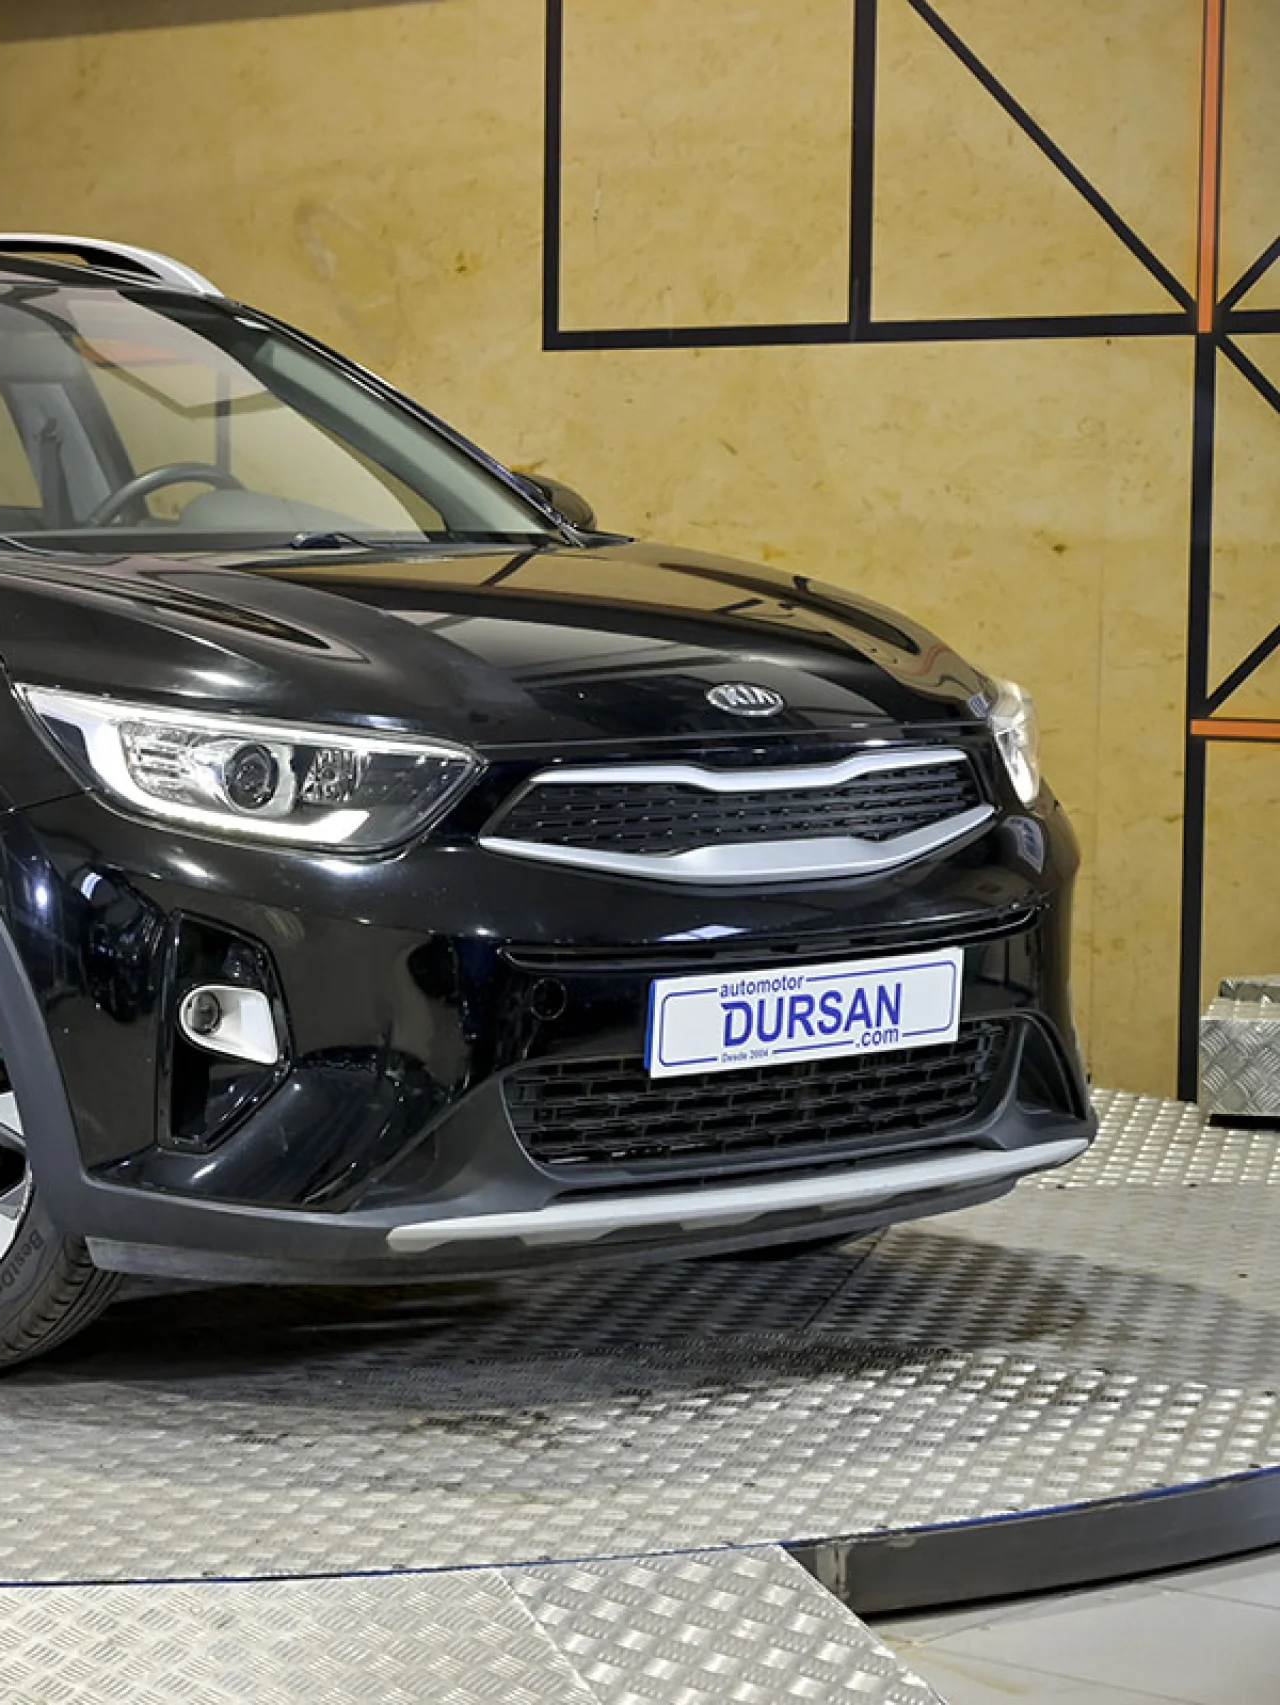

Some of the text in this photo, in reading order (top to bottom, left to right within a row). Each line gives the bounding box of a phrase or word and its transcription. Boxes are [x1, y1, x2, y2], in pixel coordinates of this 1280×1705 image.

[720, 975, 804, 998] automotor
[720, 982, 903, 1048] DURSAN
[854, 1028, 899, 1048] .com
